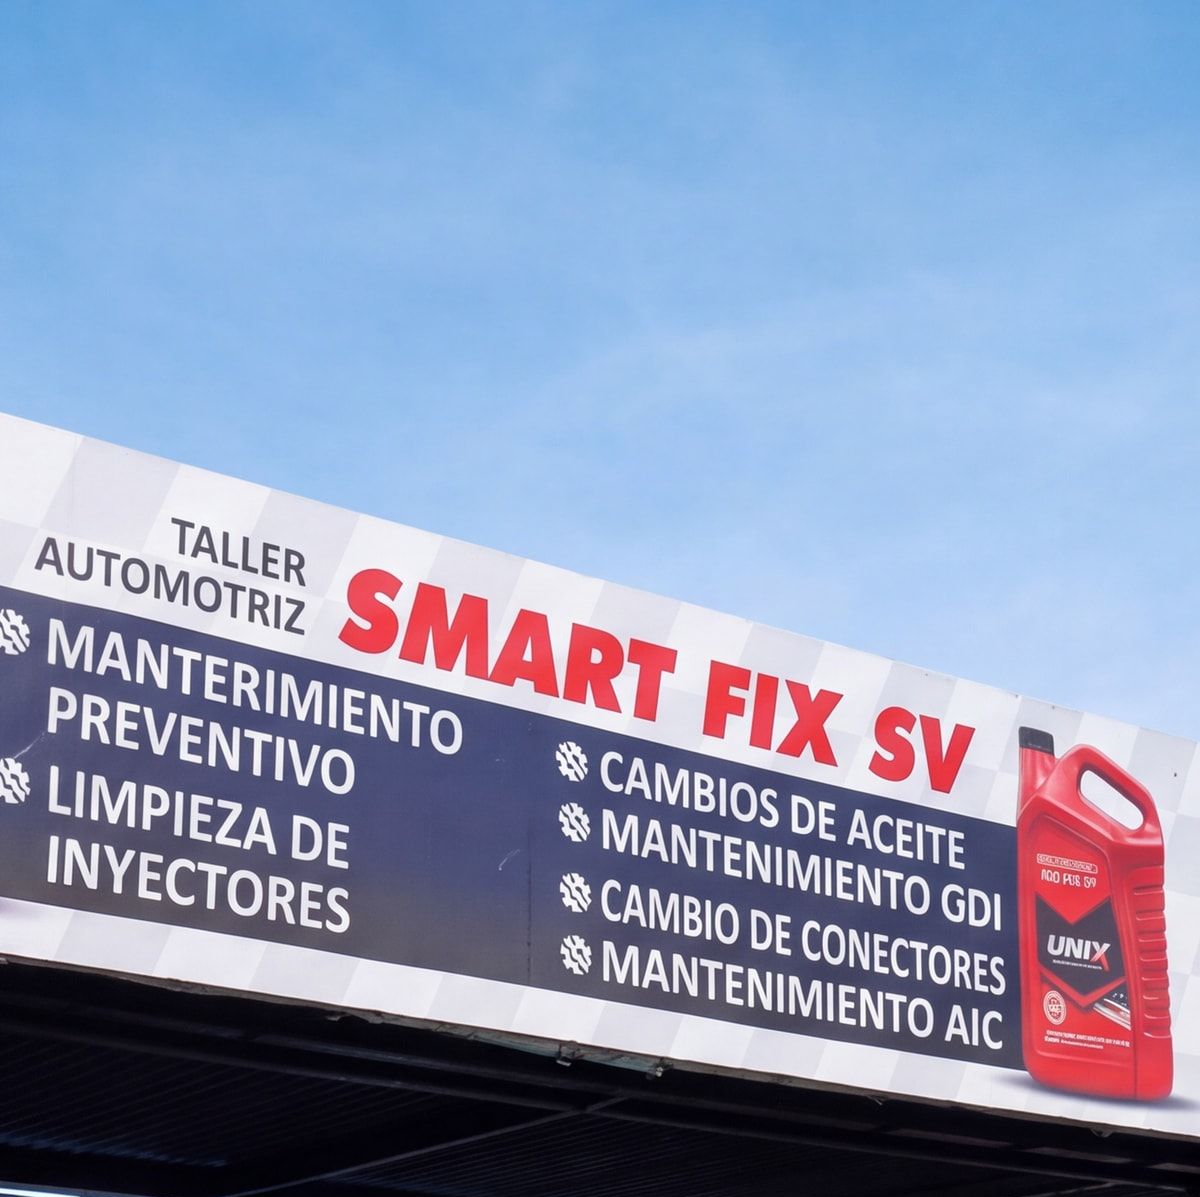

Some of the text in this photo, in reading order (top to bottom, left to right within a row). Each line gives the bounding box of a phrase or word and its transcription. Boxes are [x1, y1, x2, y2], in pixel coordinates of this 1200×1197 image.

[35, 537, 306, 635] AUTOMOTRIZ
[171, 517, 306, 586] TALLER
[47, 618, 463, 755] MANTERIMIENTO
[338, 568, 975, 794] SMART FIX SV
[47, 687, 356, 795] PREVENTIVO
[48, 765, 350, 870] LIMPIEZA DE
[600, 751, 966, 870] CAMBIOS DE ACEITE
[47, 836, 351, 933] INYECTORES
[601, 811, 1001, 931] MANTENIMIENTO GDI
[601, 880, 1006, 997] CAMBIO DE CONECTORES
[1047, 934, 1111, 972] UNIX
[601, 941, 934, 1038] MANTENIMIENTO
[944, 1005, 1003, 1050] AIC
